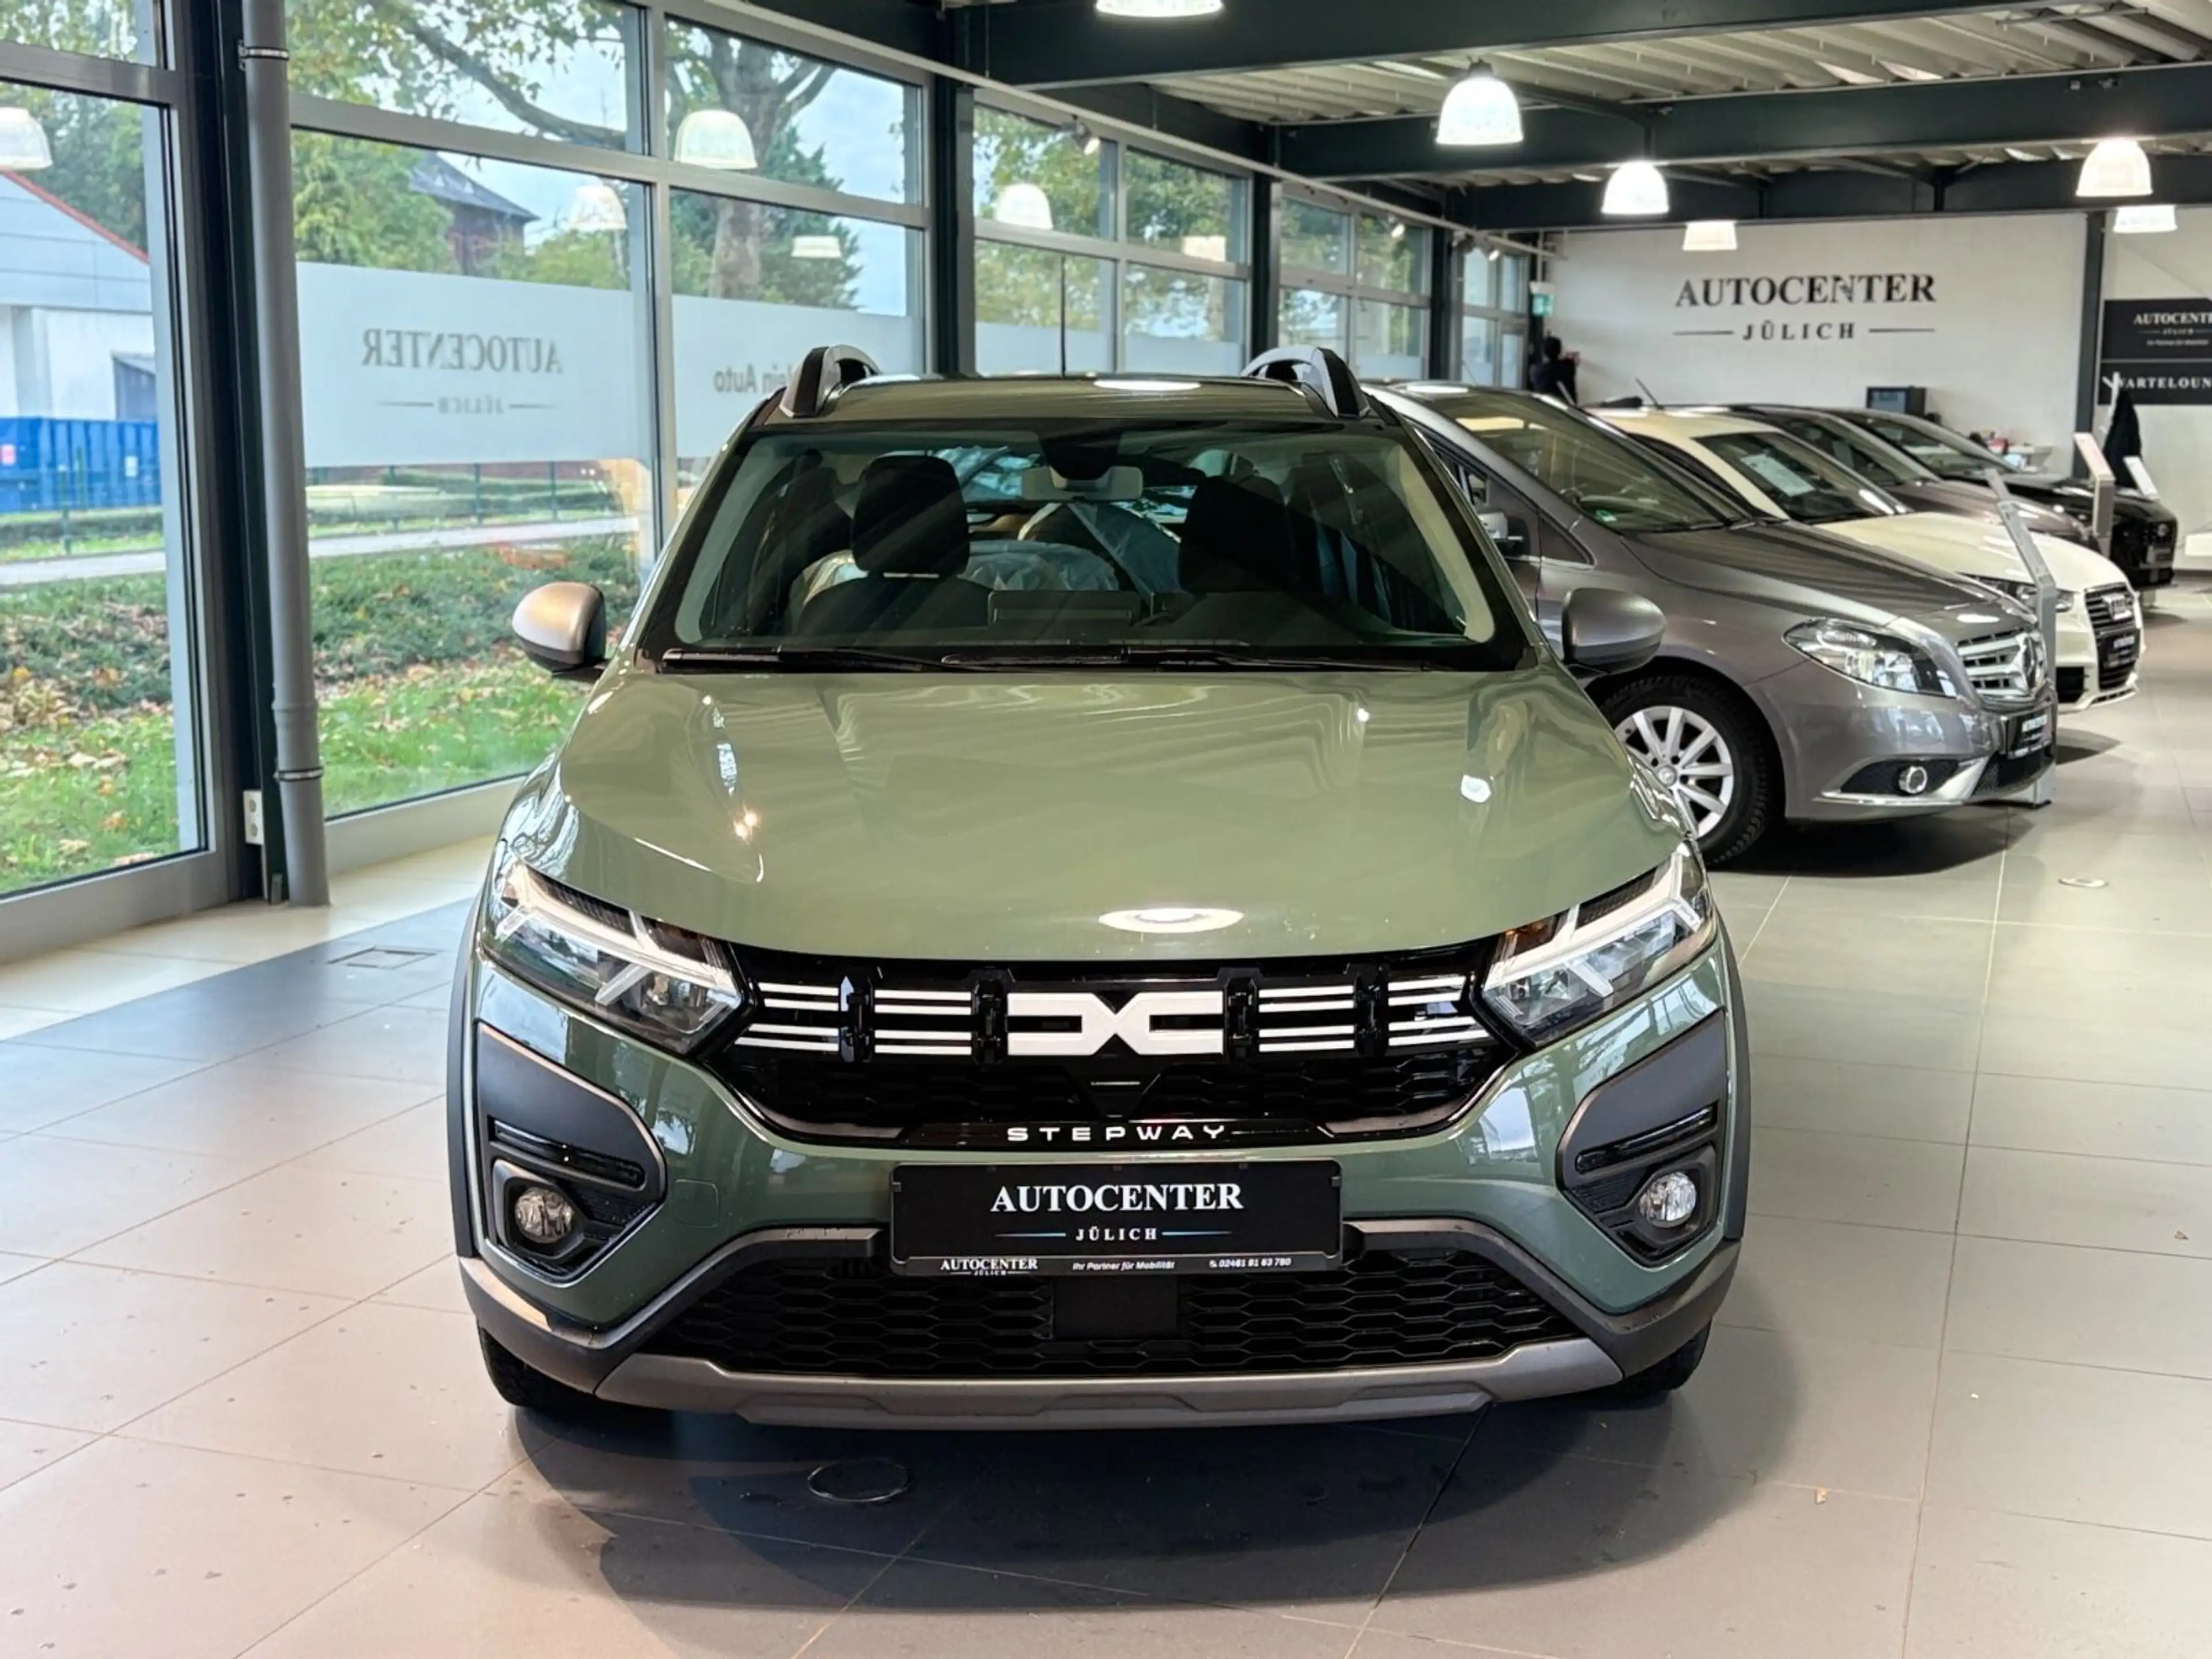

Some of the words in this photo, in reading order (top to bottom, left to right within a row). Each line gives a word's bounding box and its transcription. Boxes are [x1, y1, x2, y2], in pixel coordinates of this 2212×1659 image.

[1675, 274, 1936, 308] AUTOCENTER
[1743, 320, 1855, 341] JÜLICH
[1007, 1125, 1225, 1142] STEPWAY
[990, 1183, 1244, 1212] AUTOCENTER
[1075, 1226, 1157, 1241] JÜLICH
[940, 1259, 1038, 1270] AUTOCENTER
[1086, 1262, 1120, 1270] Partner
[1120, 1260, 1135, 1271] für
